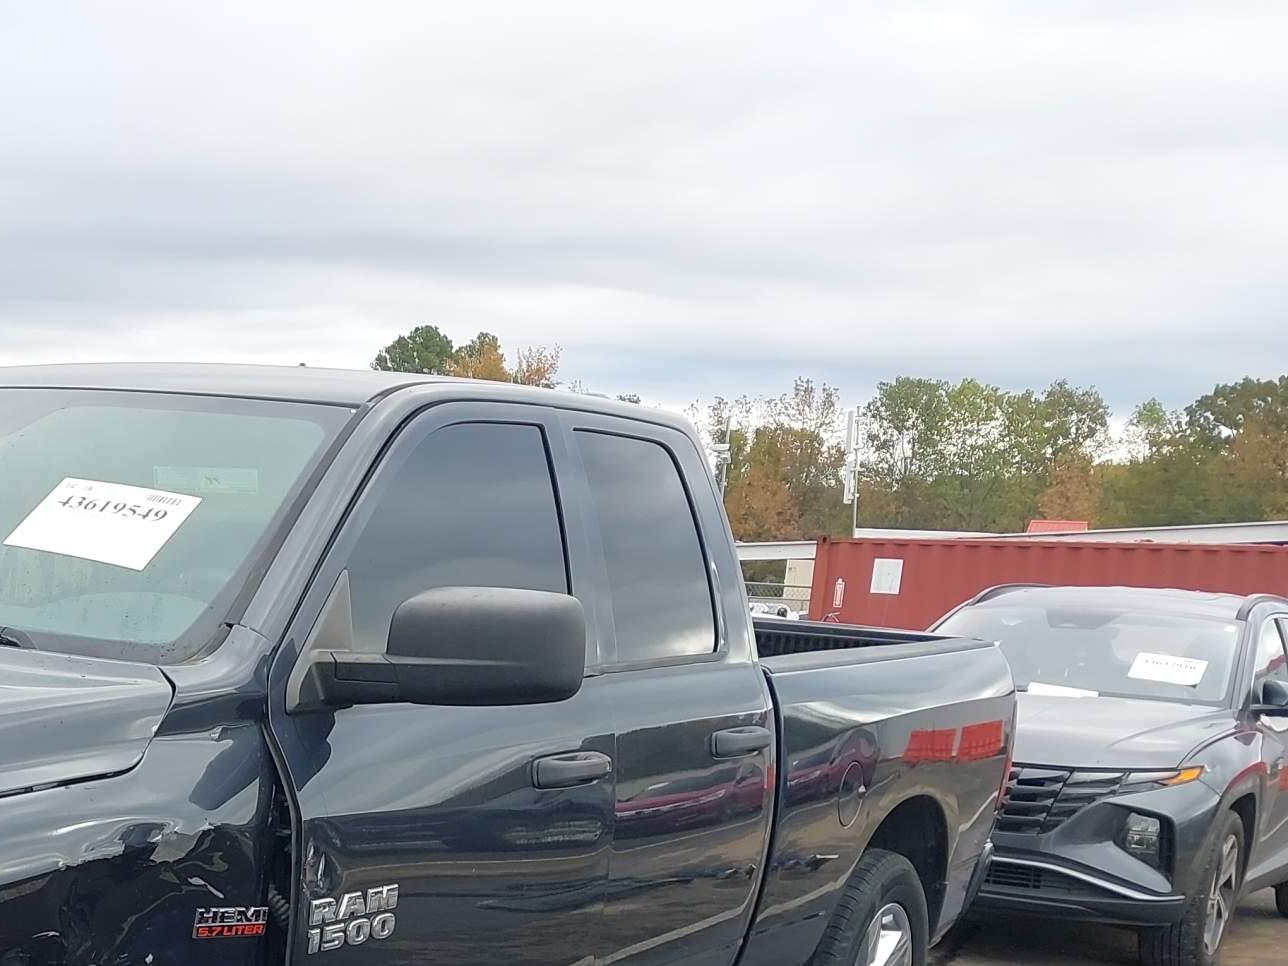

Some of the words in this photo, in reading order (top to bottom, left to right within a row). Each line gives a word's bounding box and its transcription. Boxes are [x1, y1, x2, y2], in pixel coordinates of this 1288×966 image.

[57, 495, 168, 522] 43619549
[194, 906, 269, 926] HEMI
[309, 882, 400, 926] RAM
[197, 924, 222, 938] 5.7
[222, 923, 264, 937] LITER
[307, 912, 397, 955] 1500
